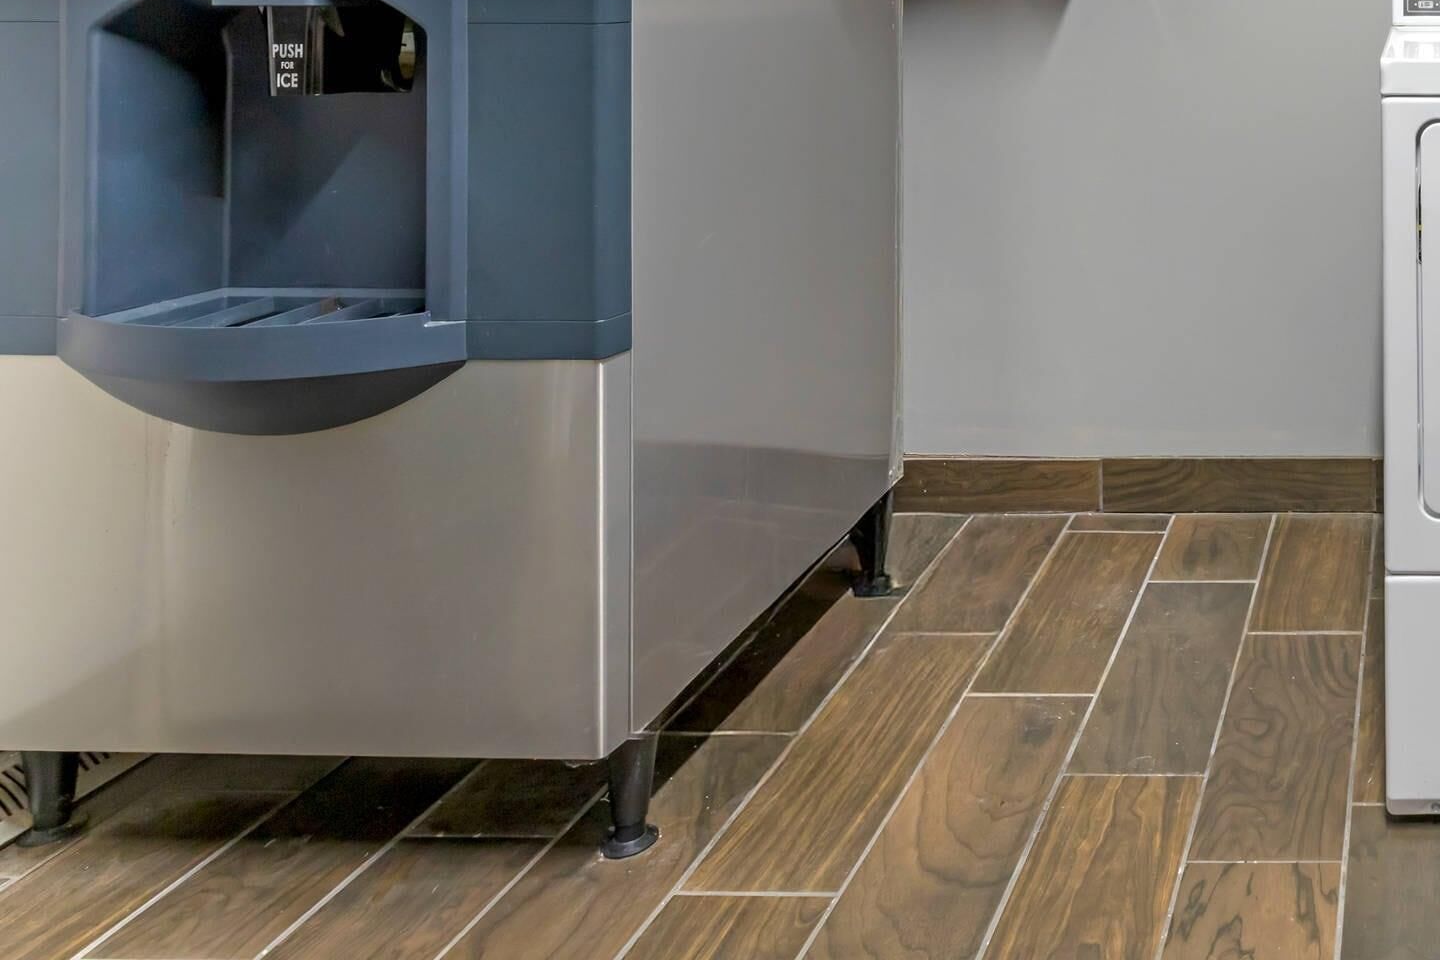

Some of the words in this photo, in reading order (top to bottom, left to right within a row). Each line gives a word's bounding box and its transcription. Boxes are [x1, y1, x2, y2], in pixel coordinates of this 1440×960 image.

[272, 43, 304, 58] PUSH
[280, 61, 294, 70] FOR
[276, 73, 298, 88] ICE
